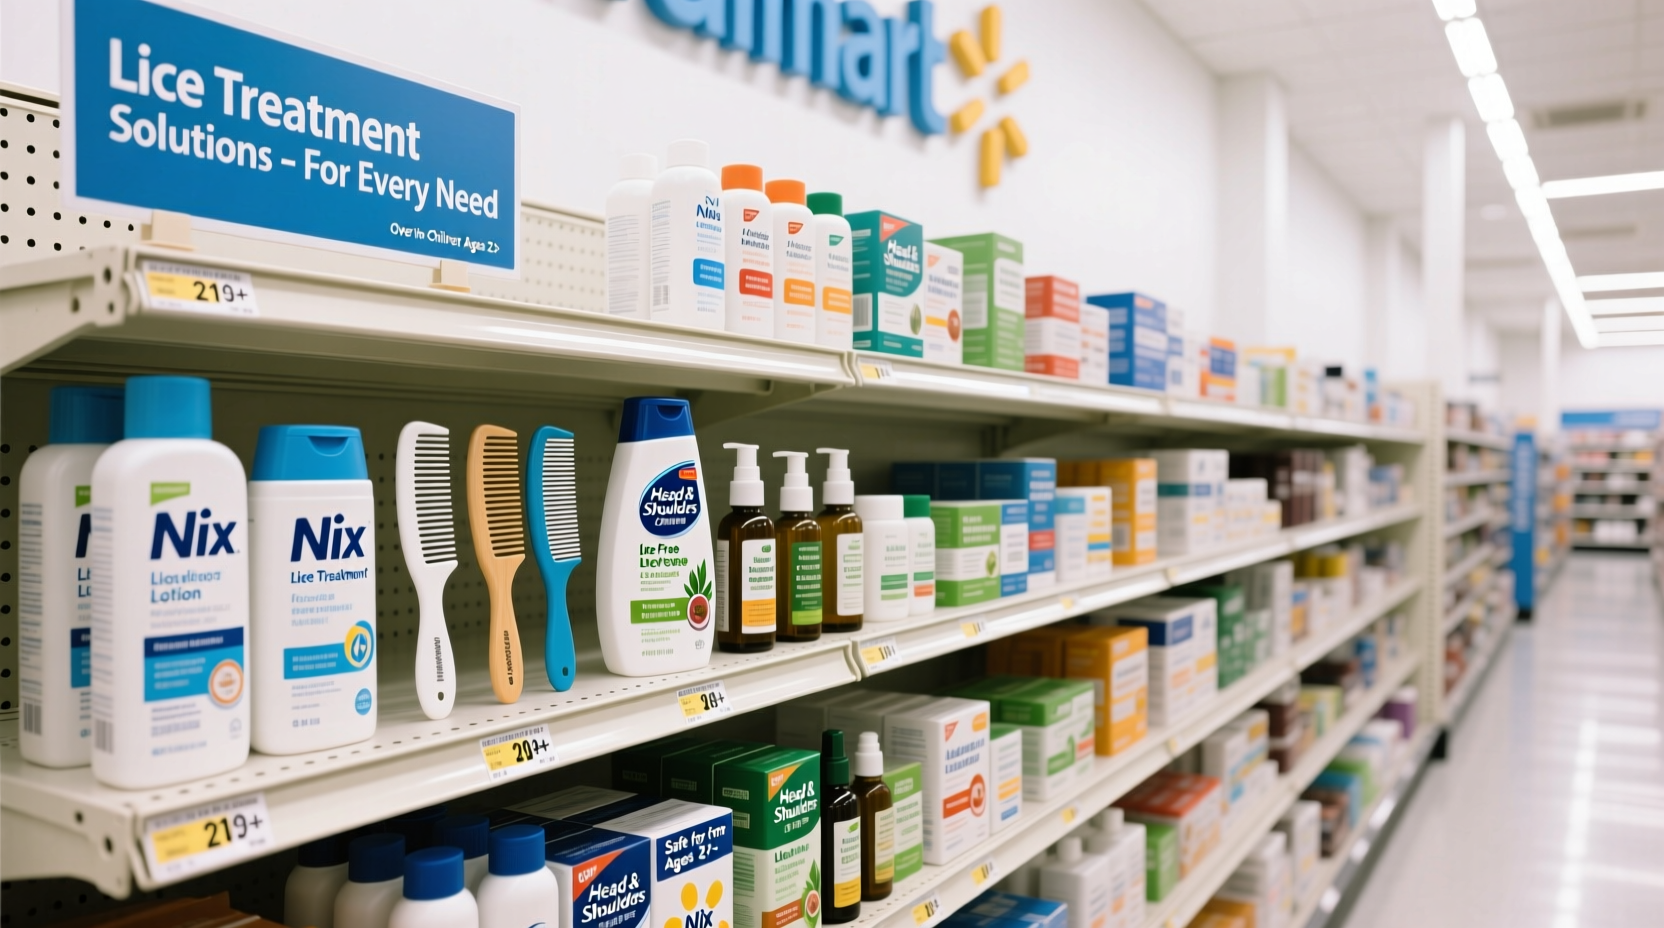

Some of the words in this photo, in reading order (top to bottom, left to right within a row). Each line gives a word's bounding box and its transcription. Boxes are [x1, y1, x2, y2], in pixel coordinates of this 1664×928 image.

[109, 37, 205, 109] Lice
[214, 65, 421, 161] Treatment
[108, 103, 272, 172] Solutions
[304, 147, 350, 188] For
[358, 160, 429, 212] Every
[436, 177, 498, 219] Need
[150, 508, 237, 560] Nix
[290, 513, 367, 562] Nix
[150, 587, 202, 604] Lotion
[588, 874, 628, 903] Head
